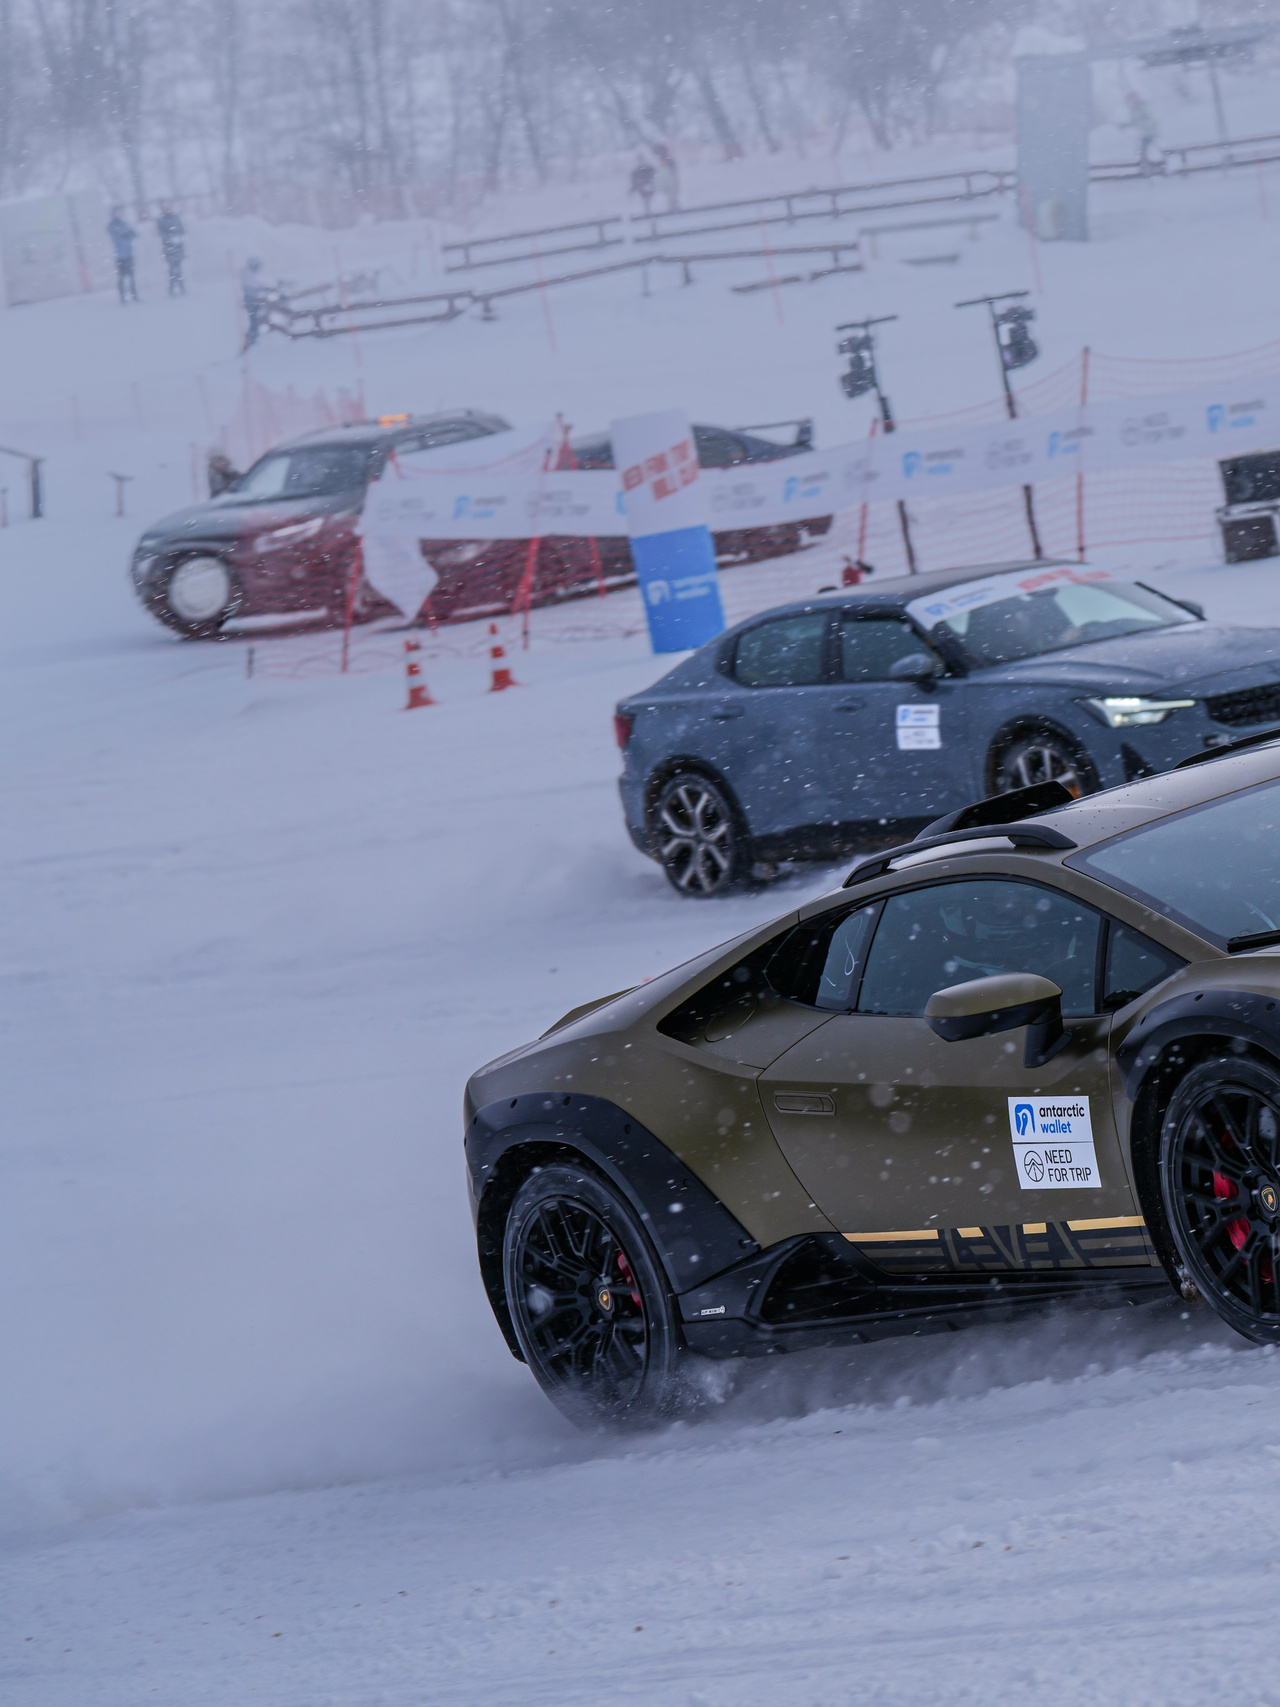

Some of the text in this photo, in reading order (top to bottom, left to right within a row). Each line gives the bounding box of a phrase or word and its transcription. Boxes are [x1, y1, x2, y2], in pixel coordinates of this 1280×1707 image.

[1039, 1103, 1085, 1118] antarctic
[1040, 1119, 1072, 1134] wallet
[1044, 1149, 1073, 1164] NEED
[1047, 1167, 1092, 1182] FOR TRIP
